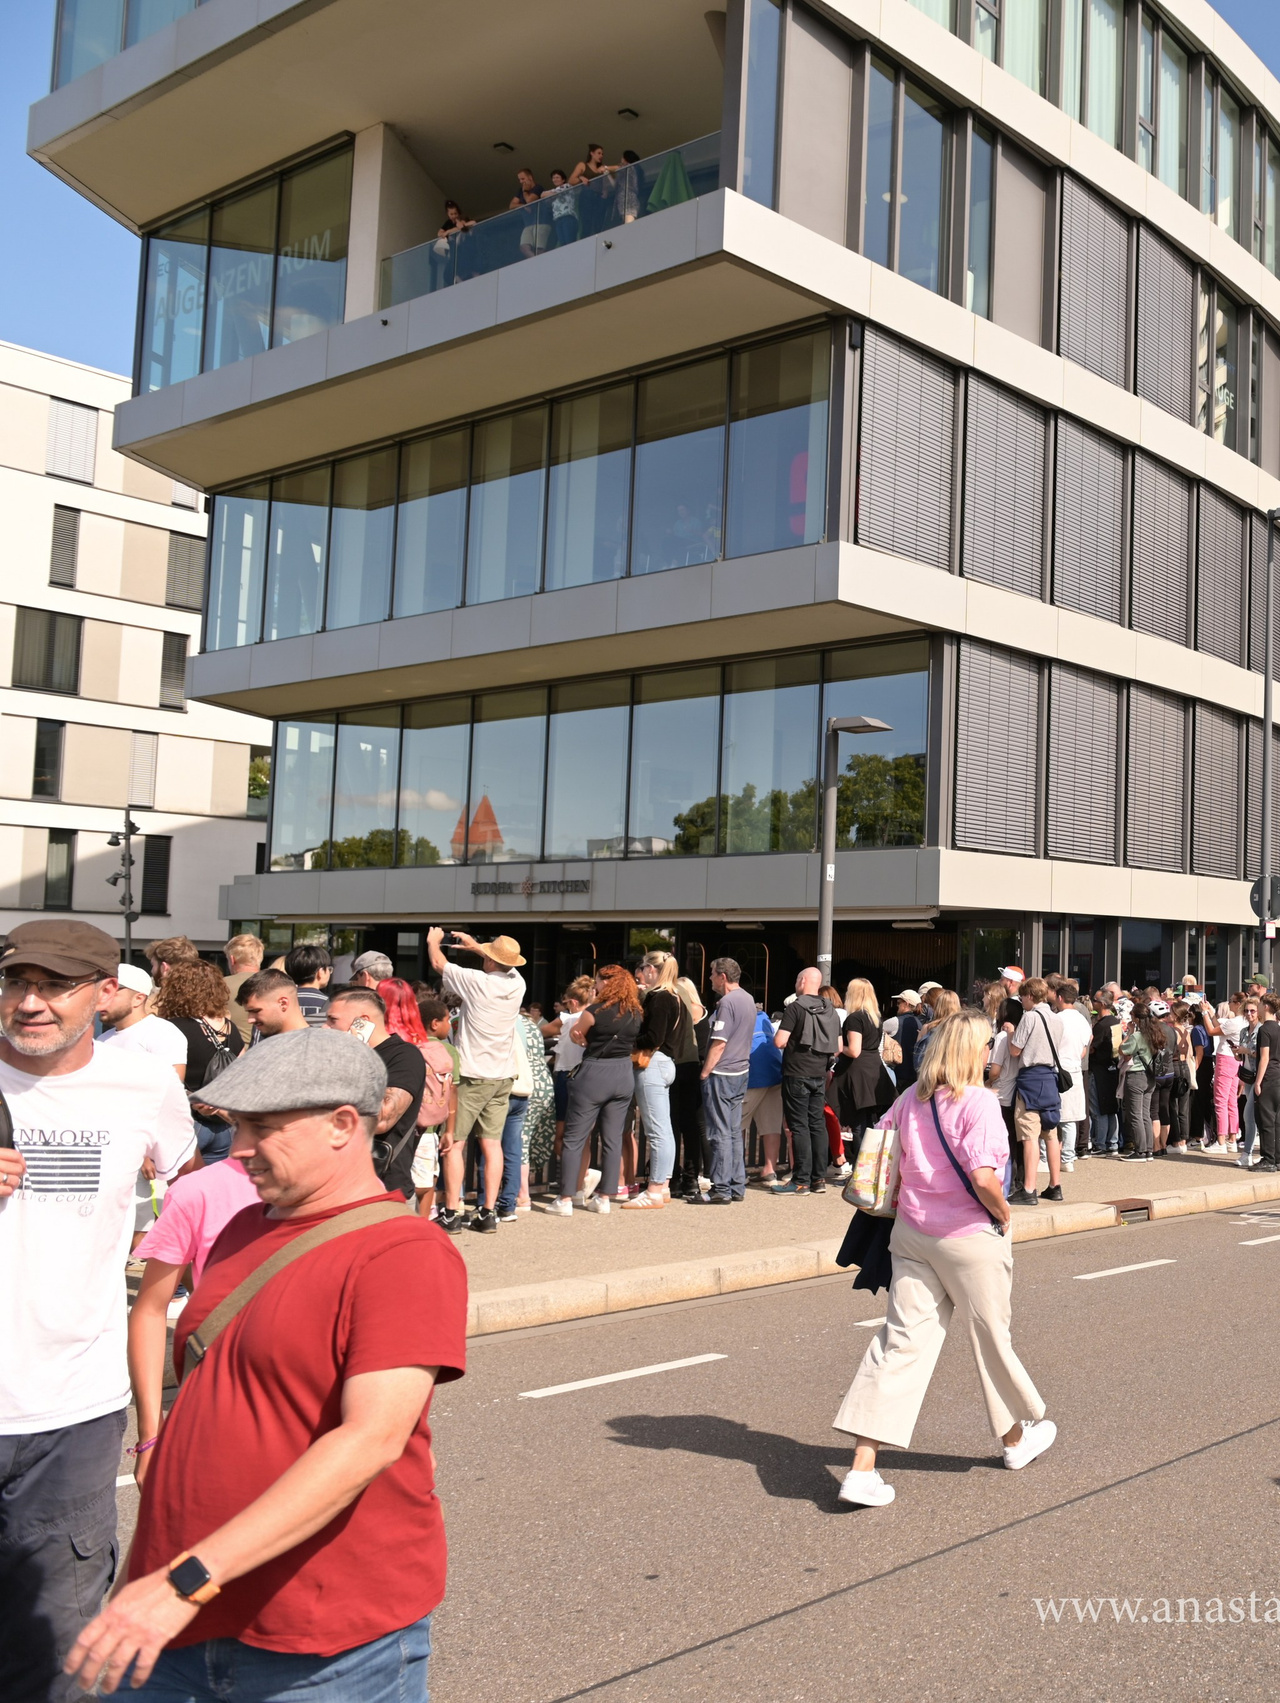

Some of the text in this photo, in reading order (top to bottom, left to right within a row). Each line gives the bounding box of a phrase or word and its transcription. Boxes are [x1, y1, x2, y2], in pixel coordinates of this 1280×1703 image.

[154, 229, 332, 326] AUGENZENTRUM
[471, 879, 591, 895] BUDDHA KITCHEN
[12, 1128, 111, 1146] NMORE
[55, 1193, 98, 1203] COUP
